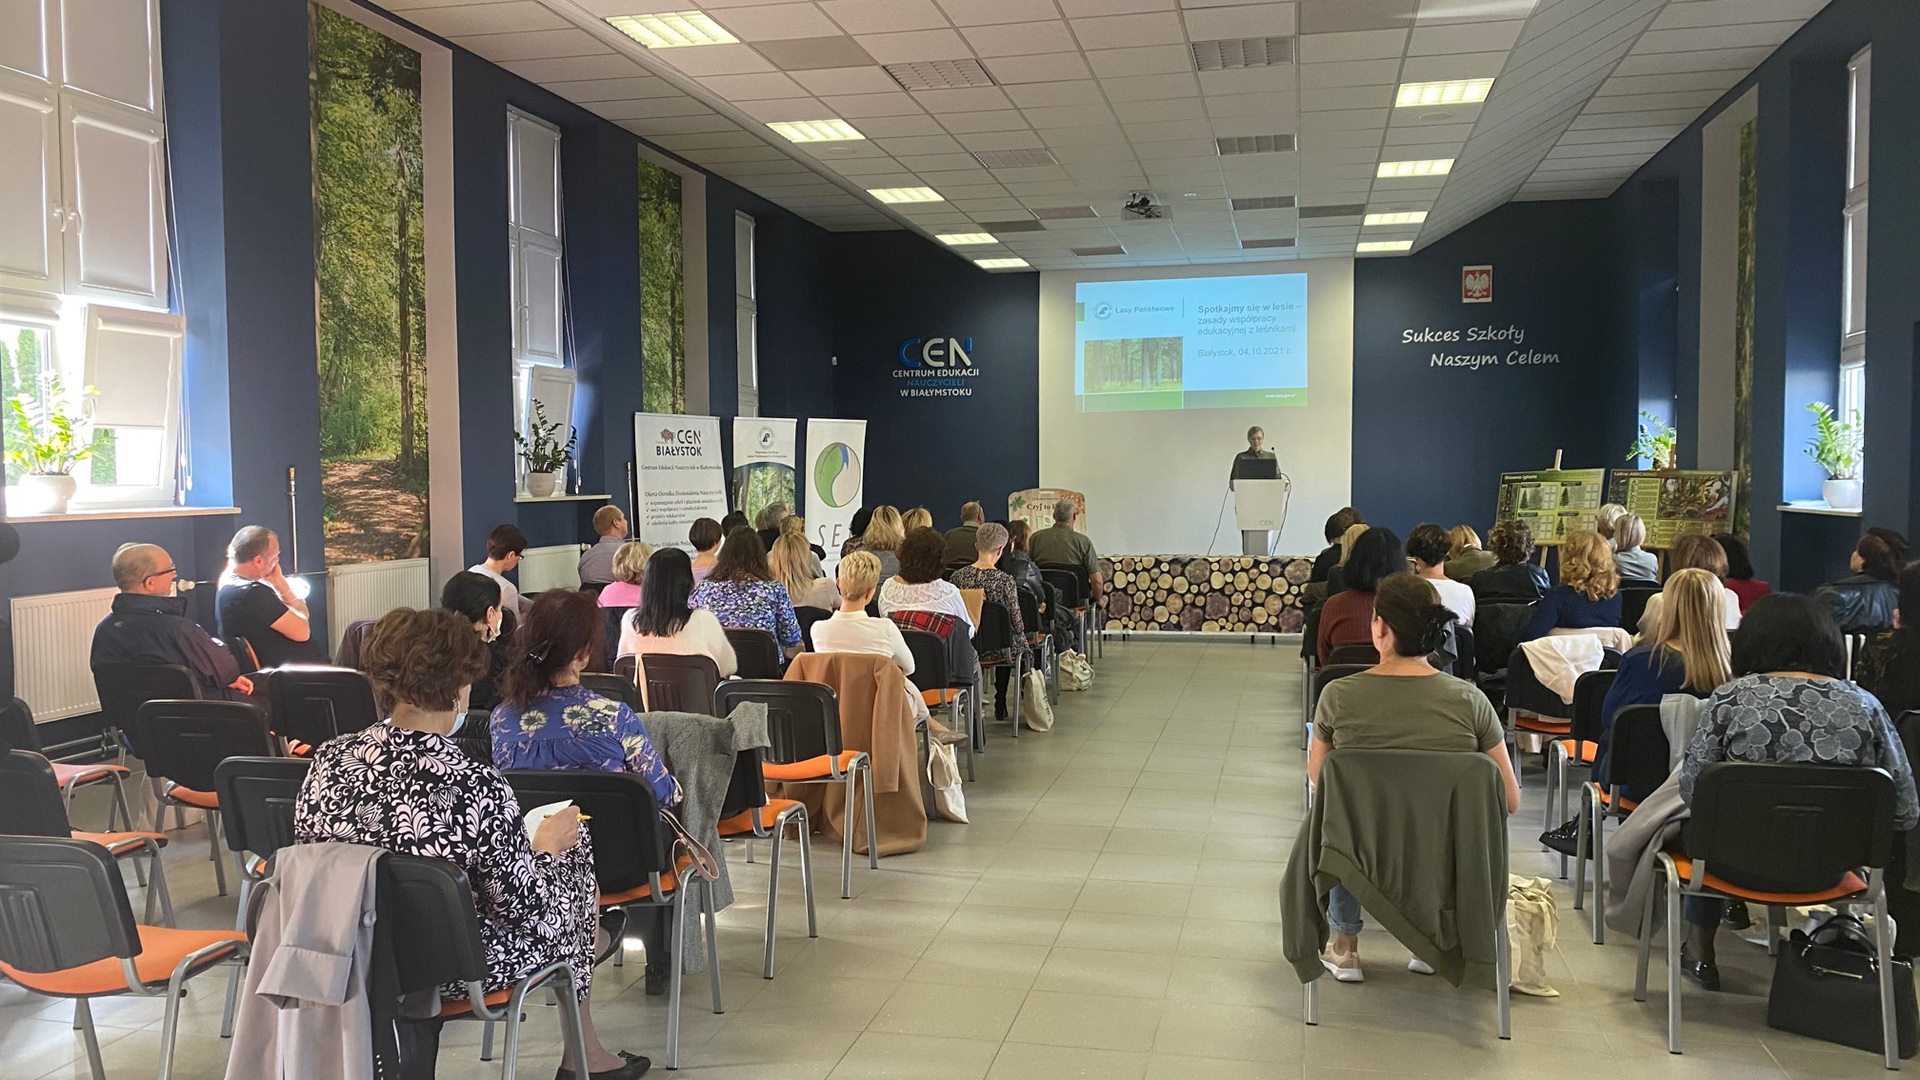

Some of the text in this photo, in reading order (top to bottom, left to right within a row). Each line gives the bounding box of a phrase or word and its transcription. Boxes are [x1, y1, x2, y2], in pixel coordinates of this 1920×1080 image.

[1115, 306, 1132, 315] Lasy
[1134, 304, 1175, 313] Państwowe
[1198, 303, 1245, 315] Spotkajmy
[1246, 302, 1260, 314] się
[1272, 302, 1294, 311] lesie
[1198, 314, 1276, 326] zasady współpracy
[1198, 326, 1247, 337] edukacyjnej
[1256, 324, 1296, 334] leśnikami
[1402, 324, 1524, 345] Sukces Szkoły
[897, 336, 973, 368] CEN
[1238, 347, 1284, 357] 04.10.2021
[1430, 349, 1560, 370] Naszym Celem
[892, 368, 979, 378] CENTRUM EDUKACJI
[906, 378, 964, 388] NAUCZYCIELI
[911, 388, 972, 397] BIAŁYMSTOKU
[677, 430, 702, 444] CEN
[656, 446, 702, 456] BIAŁYSTOK
[1026, 503, 1042, 512] Czyj
